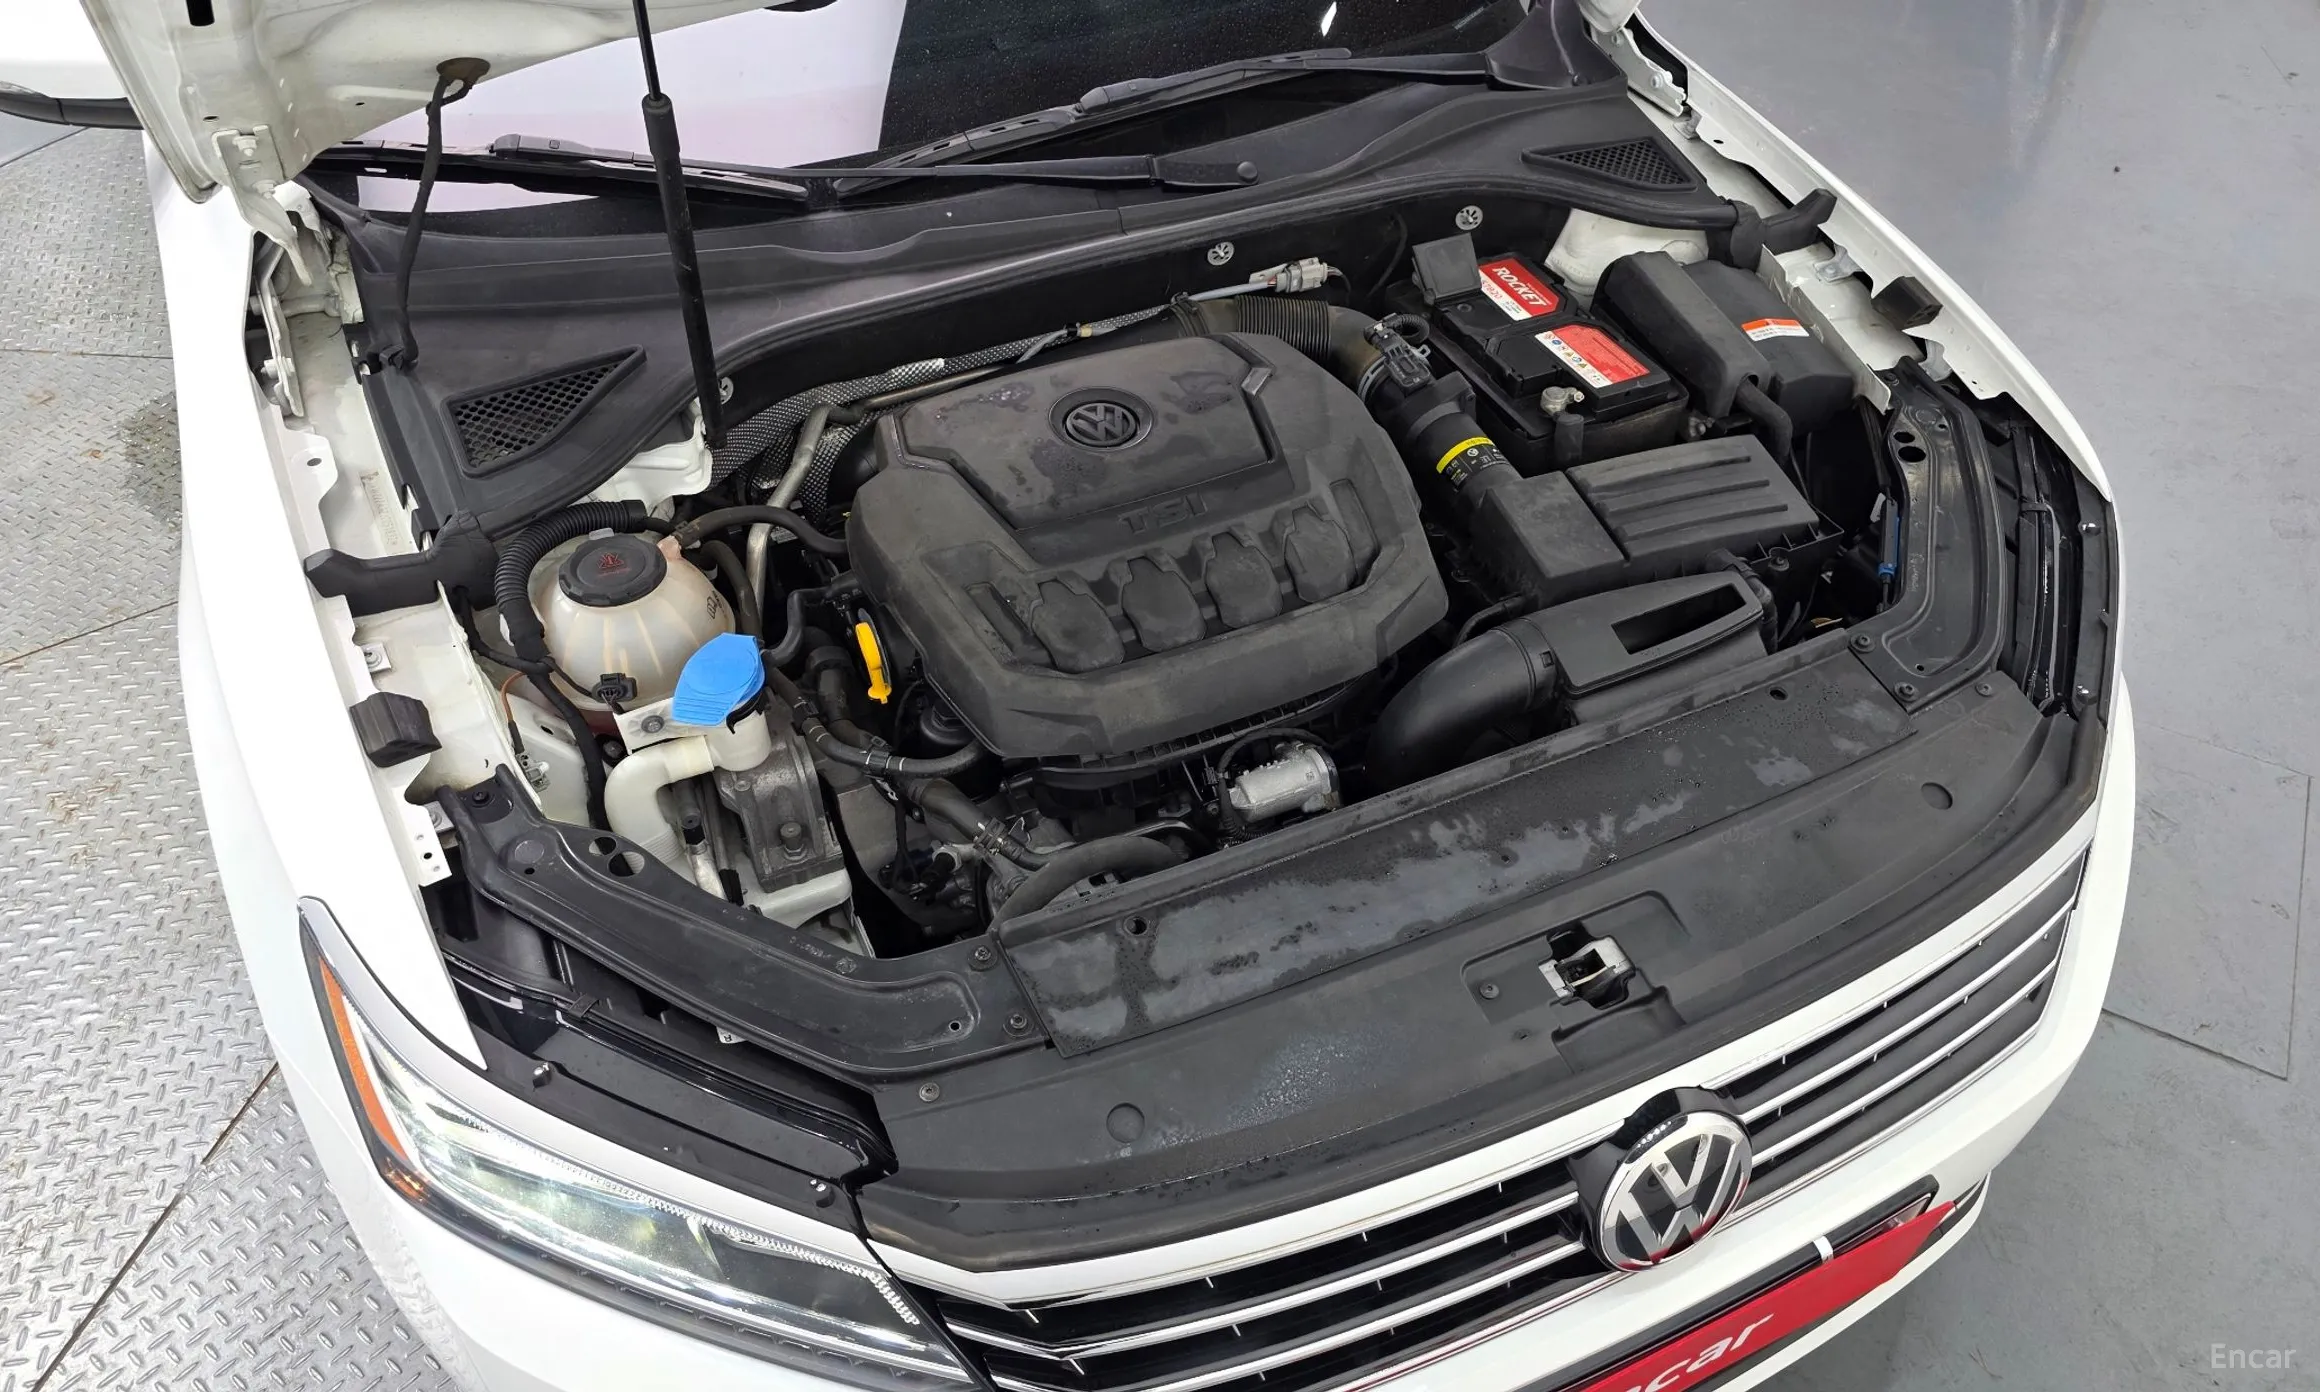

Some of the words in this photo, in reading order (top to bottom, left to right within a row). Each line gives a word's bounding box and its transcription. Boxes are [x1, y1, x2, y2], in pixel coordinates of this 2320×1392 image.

[1492, 266, 1547, 306] ROCKET
[1117, 492, 1208, 535] TSI
[1625, 1313, 1775, 1392] car
